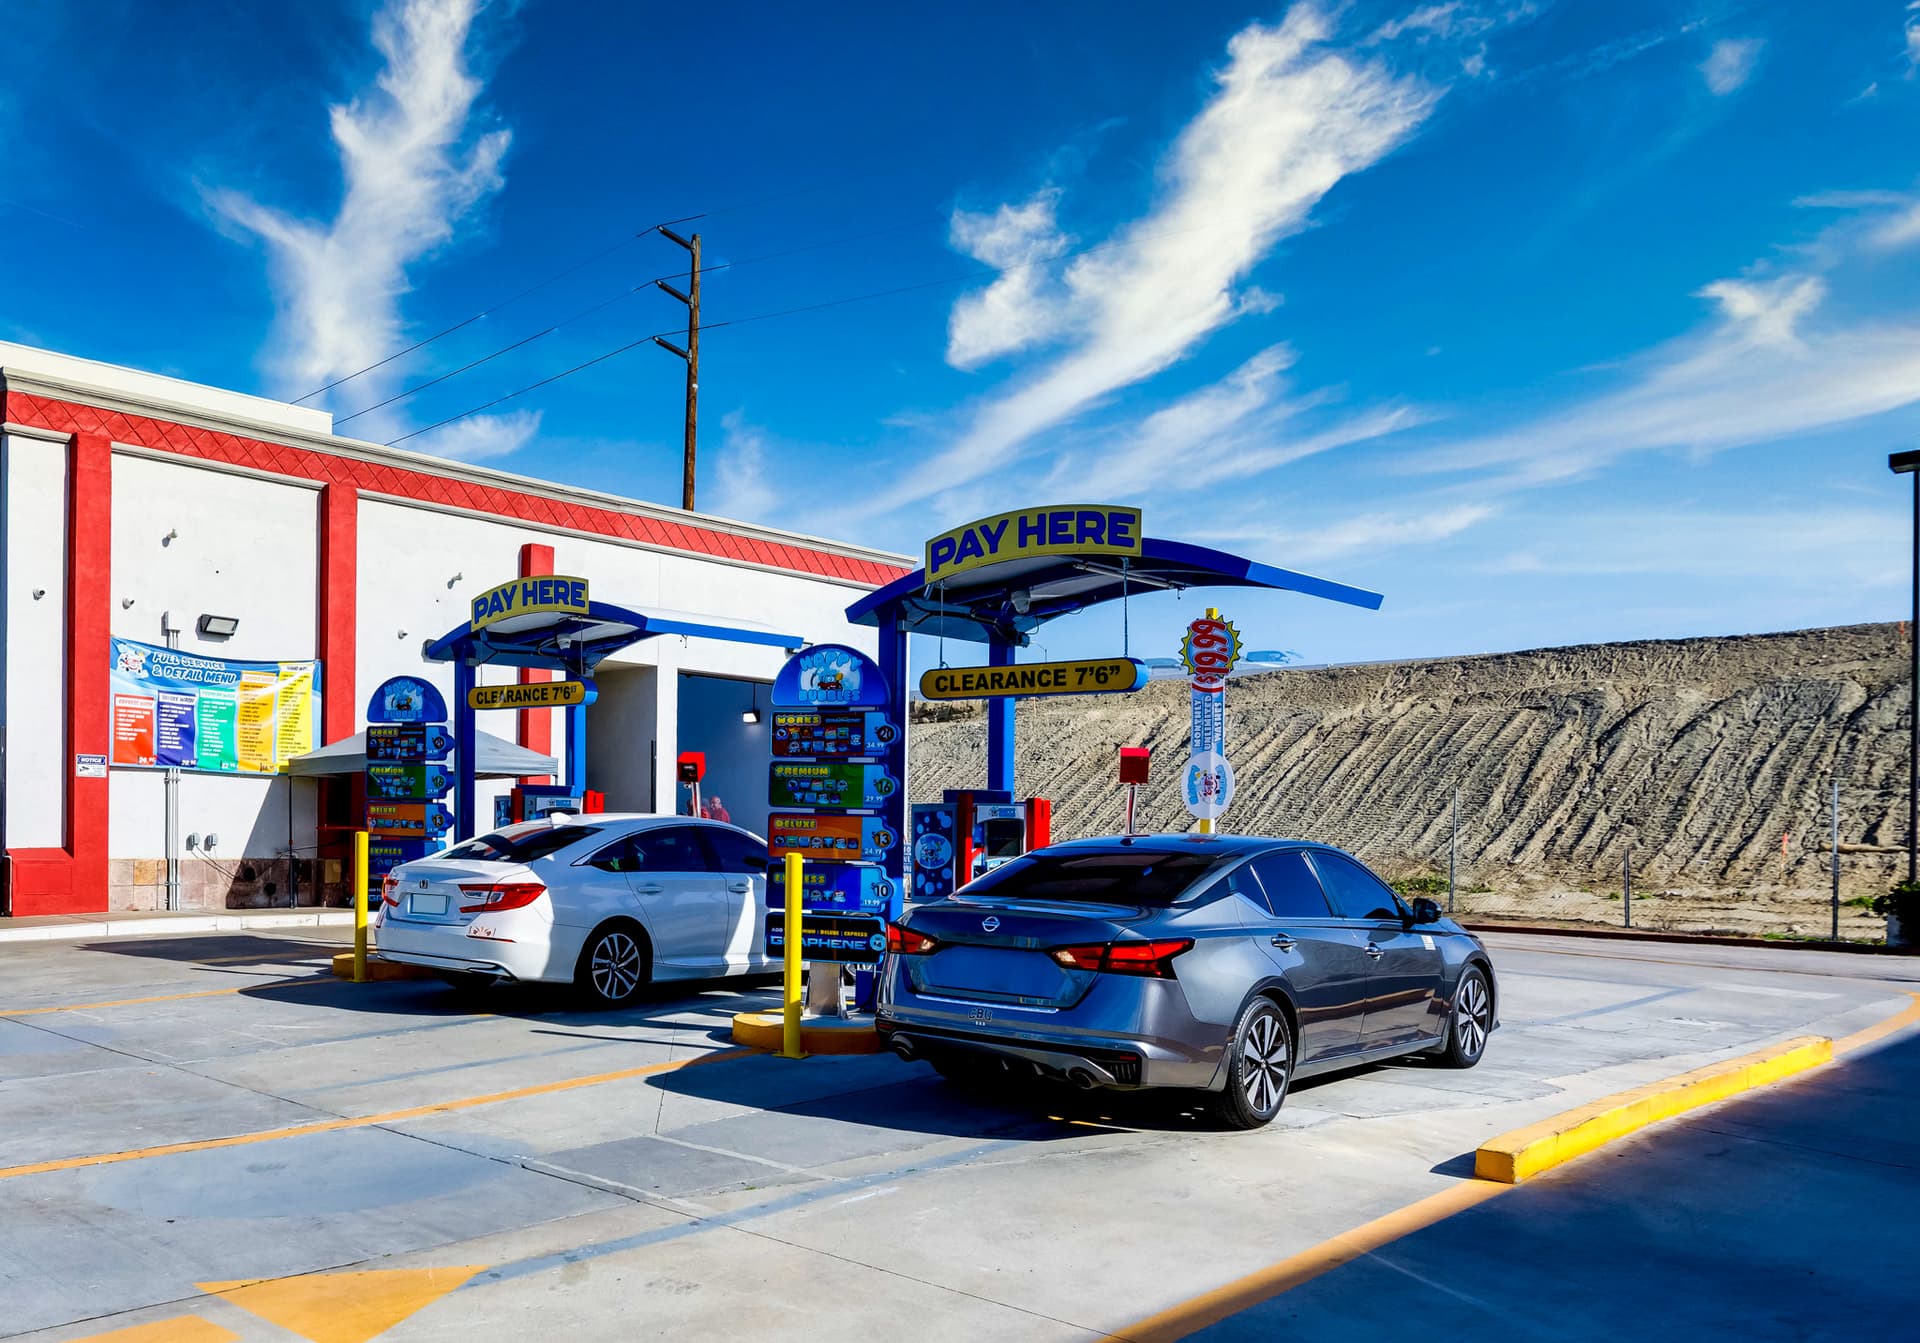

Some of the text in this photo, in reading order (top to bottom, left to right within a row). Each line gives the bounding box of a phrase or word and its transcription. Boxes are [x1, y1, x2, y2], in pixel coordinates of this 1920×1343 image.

[931, 511, 1136, 573] PAY HERE
[474, 580, 586, 624] PAY HERE
[153, 652, 225, 669] FULL SERVICE
[800, 651, 863, 670] HAPPY
[1190, 618, 1230, 685] $19.99
[152, 665, 161, 676] &
[164, 667, 202, 681] DETAIL
[204, 673, 236, 684] MENU
[935, 668, 1067, 692] CLEARANCE
[476, 689, 548, 704] CLEARANCE
[799, 690, 861, 701] BUBBLES
[777, 715, 819, 724] WORKS
[1194, 699, 1202, 748] MONTHLY
[1203, 695, 1212, 750] UNLIMITED
[1214, 702, 1222, 742] WASHES
[776, 767, 829, 775] PREMIUM
[775, 820, 816, 828] DELUXE
[774, 873, 826, 883] EESS
[871, 882, 888, 897] $10
[770, 935, 867, 950] GAPHENE
